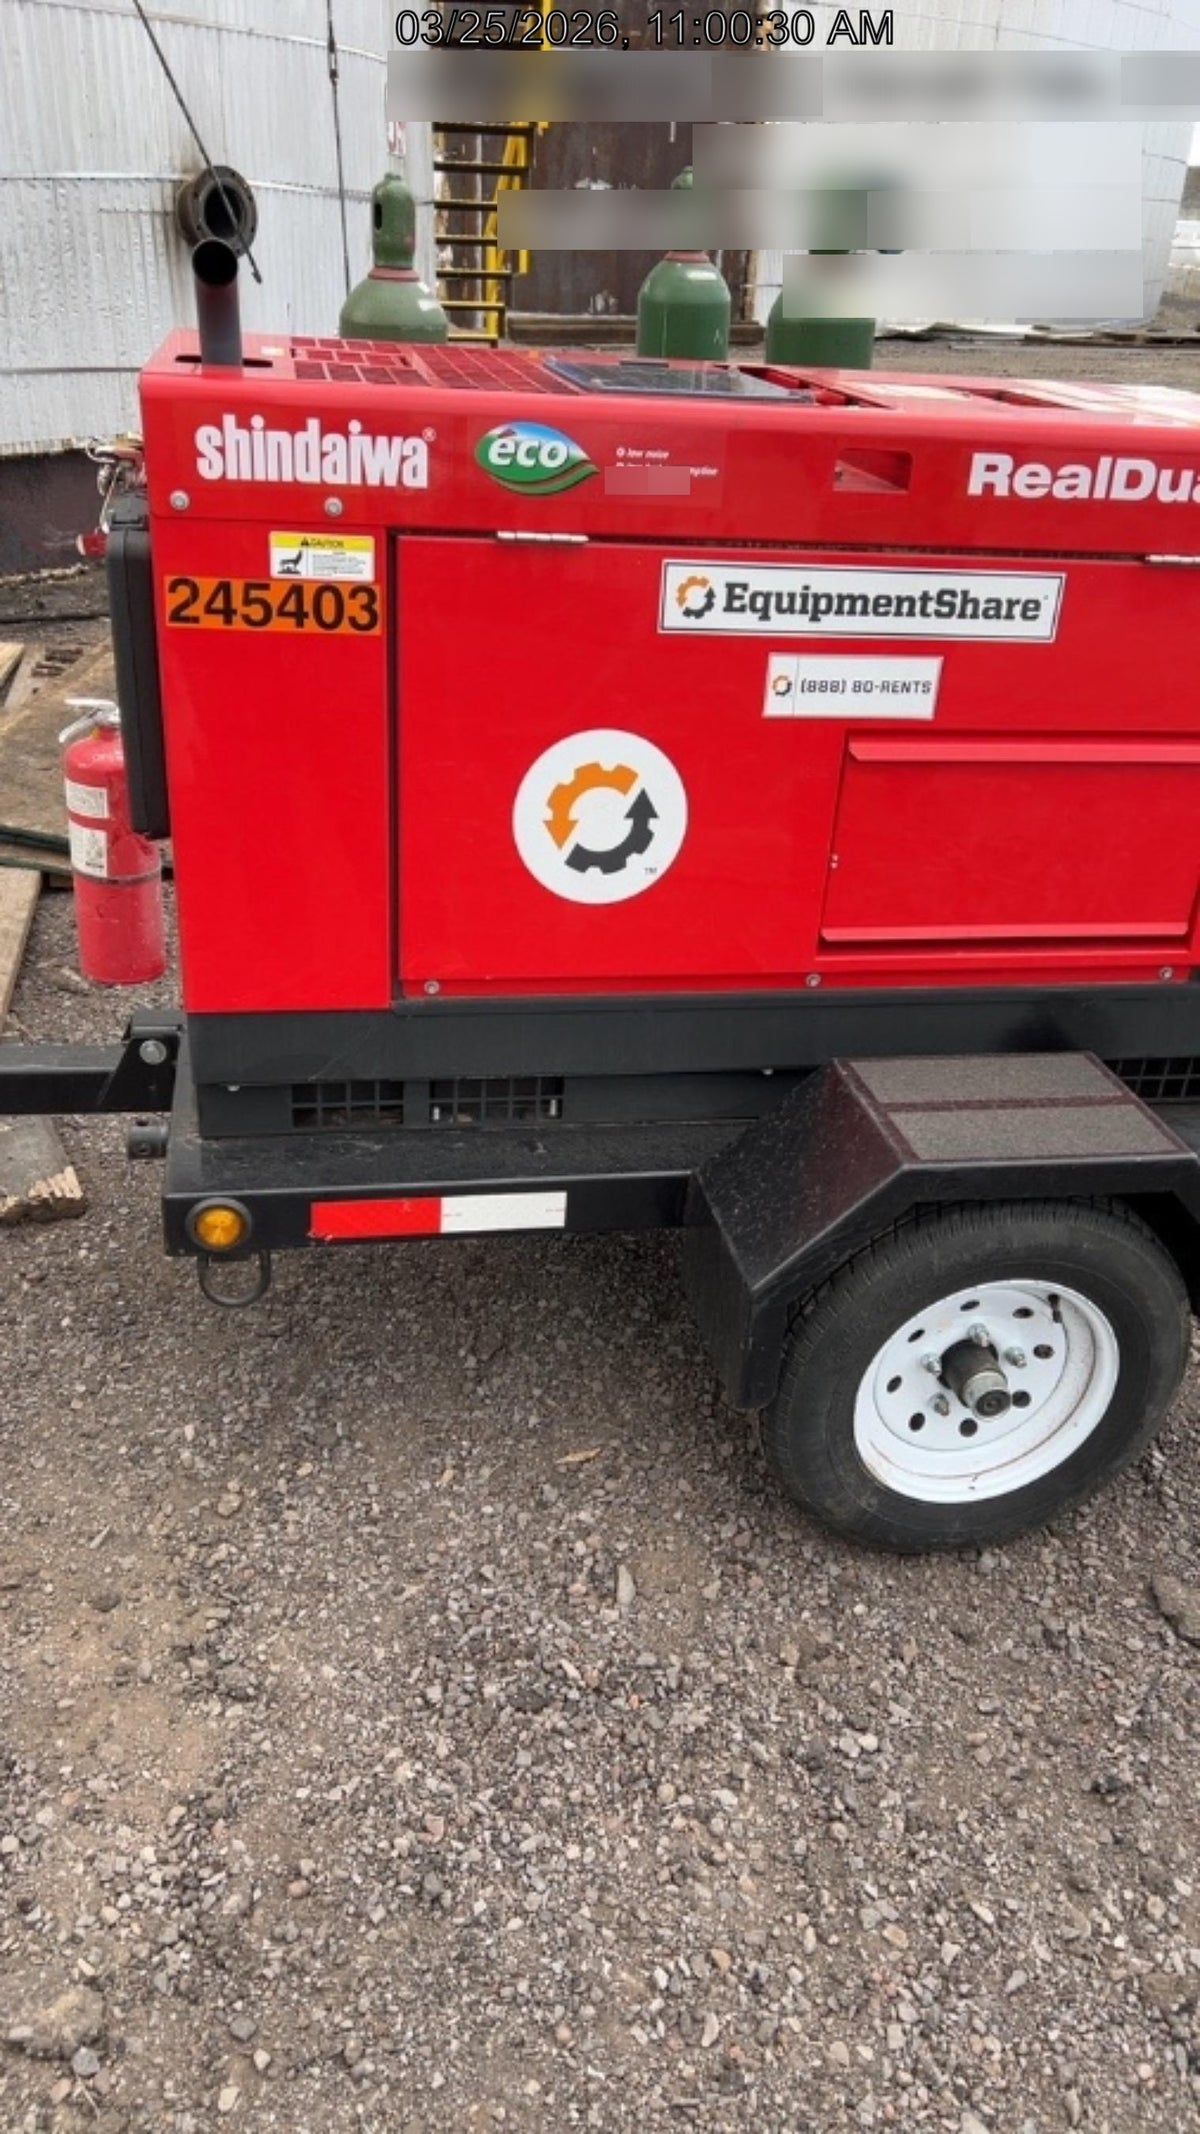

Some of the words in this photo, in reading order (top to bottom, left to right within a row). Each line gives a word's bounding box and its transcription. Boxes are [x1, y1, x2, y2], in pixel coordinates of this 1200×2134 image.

[487, 437, 569, 469] eco
[966, 451, 1200, 503] RealDu
[167, 577, 379, 632] 245403
[722, 581, 1043, 622] EquipmentShare
[800, 677, 847, 695] (888)
[851, 679, 933, 695] 80-RENTS
